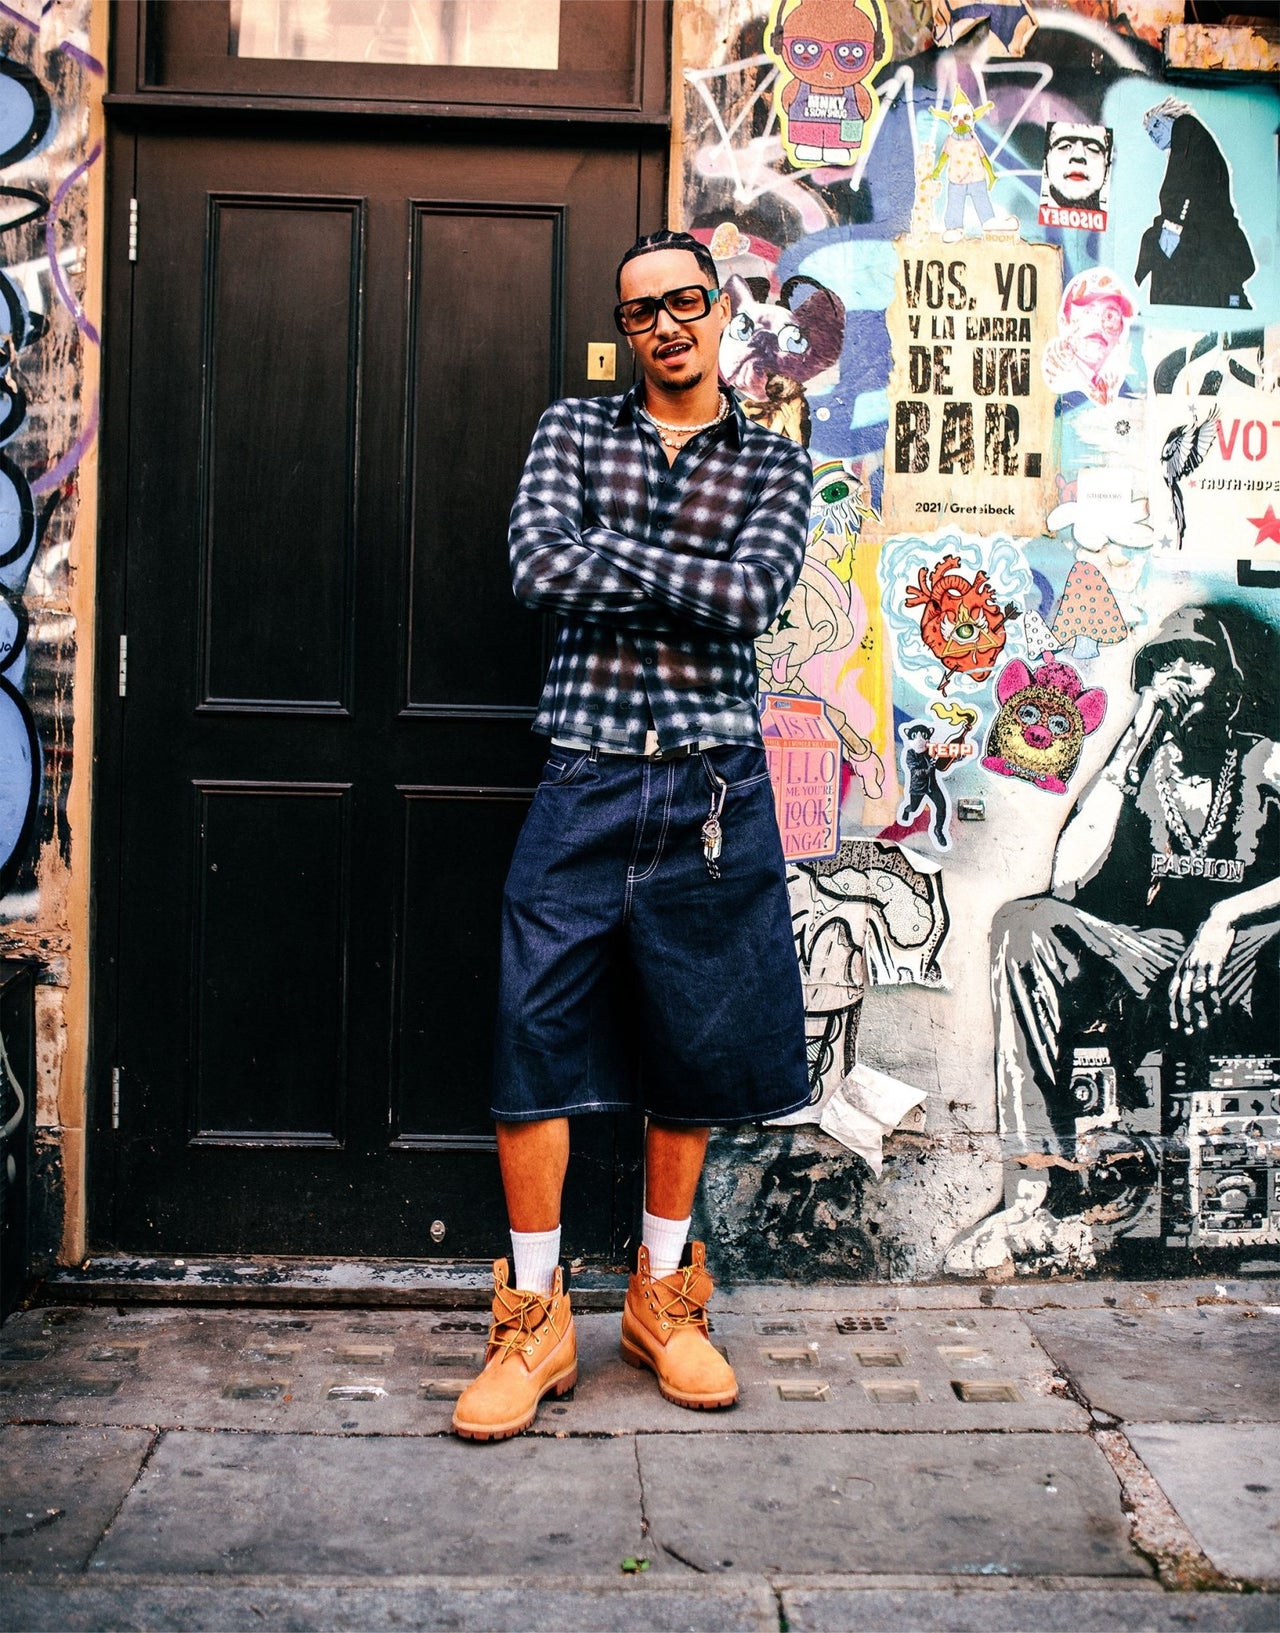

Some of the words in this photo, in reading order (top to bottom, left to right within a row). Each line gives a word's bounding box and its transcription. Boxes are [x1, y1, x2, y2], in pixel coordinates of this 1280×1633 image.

[994, 262, 1038, 312] YO
[908, 315, 922, 339] Y
[931, 315, 955, 340] LA
[966, 316, 1031, 342] BARRA
[908, 345, 954, 396] DE
[972, 347, 1031, 397] UN
[894, 400, 1042, 478] BAR.
[1215, 418, 1280, 461] VO
[915, 502, 941, 513] 2021
[780, 715, 806, 739] IS
[768, 750, 836, 785] ELLO
[786, 787, 801, 797] ME
[802, 785, 835, 797] YOU'RE
[1151, 853, 1244, 882] PASSION
